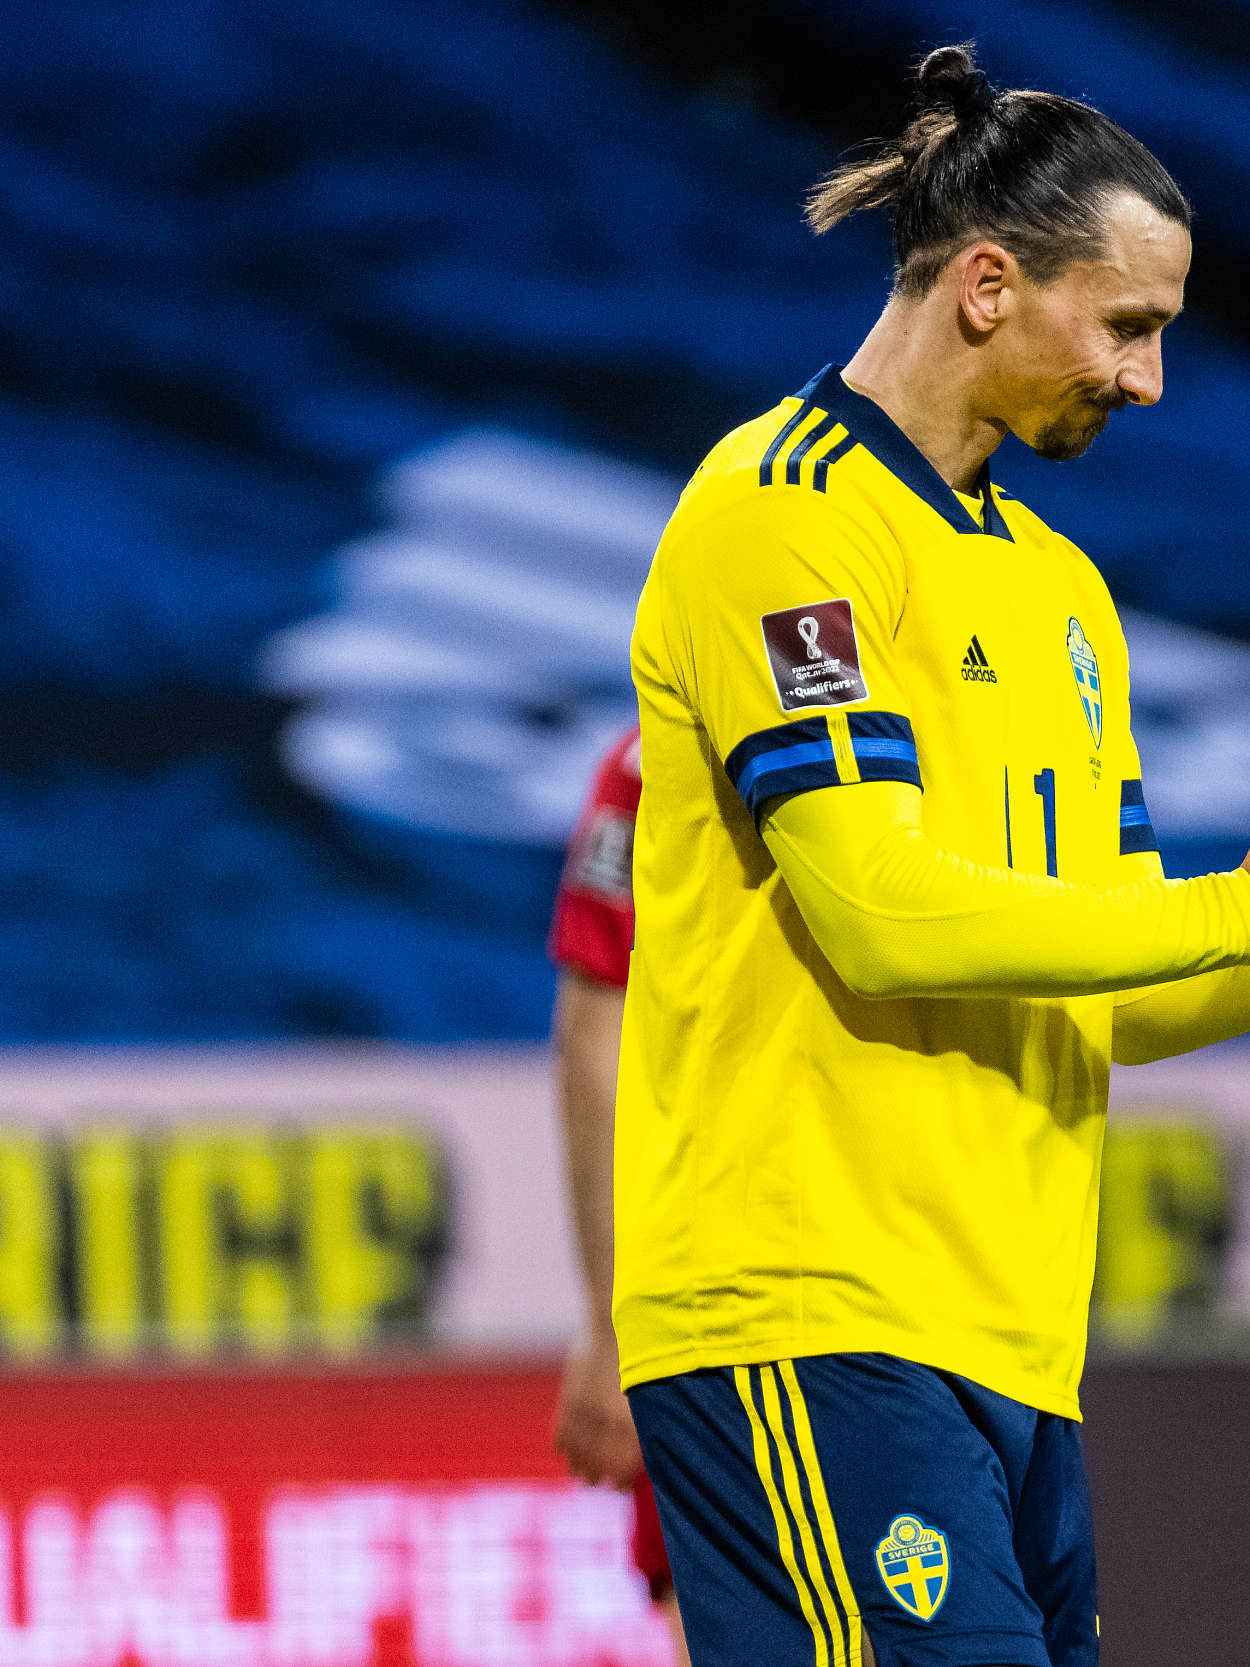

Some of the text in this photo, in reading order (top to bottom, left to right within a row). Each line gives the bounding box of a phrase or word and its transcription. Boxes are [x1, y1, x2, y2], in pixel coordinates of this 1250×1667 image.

[796, 665, 840, 680] Qatar 2022
[806, 661, 829, 670] WORLD
[961, 664, 997, 683] adidas
[794, 679, 851, 698] Qualifiers
[888, 1544, 934, 1560] SVERIGE
